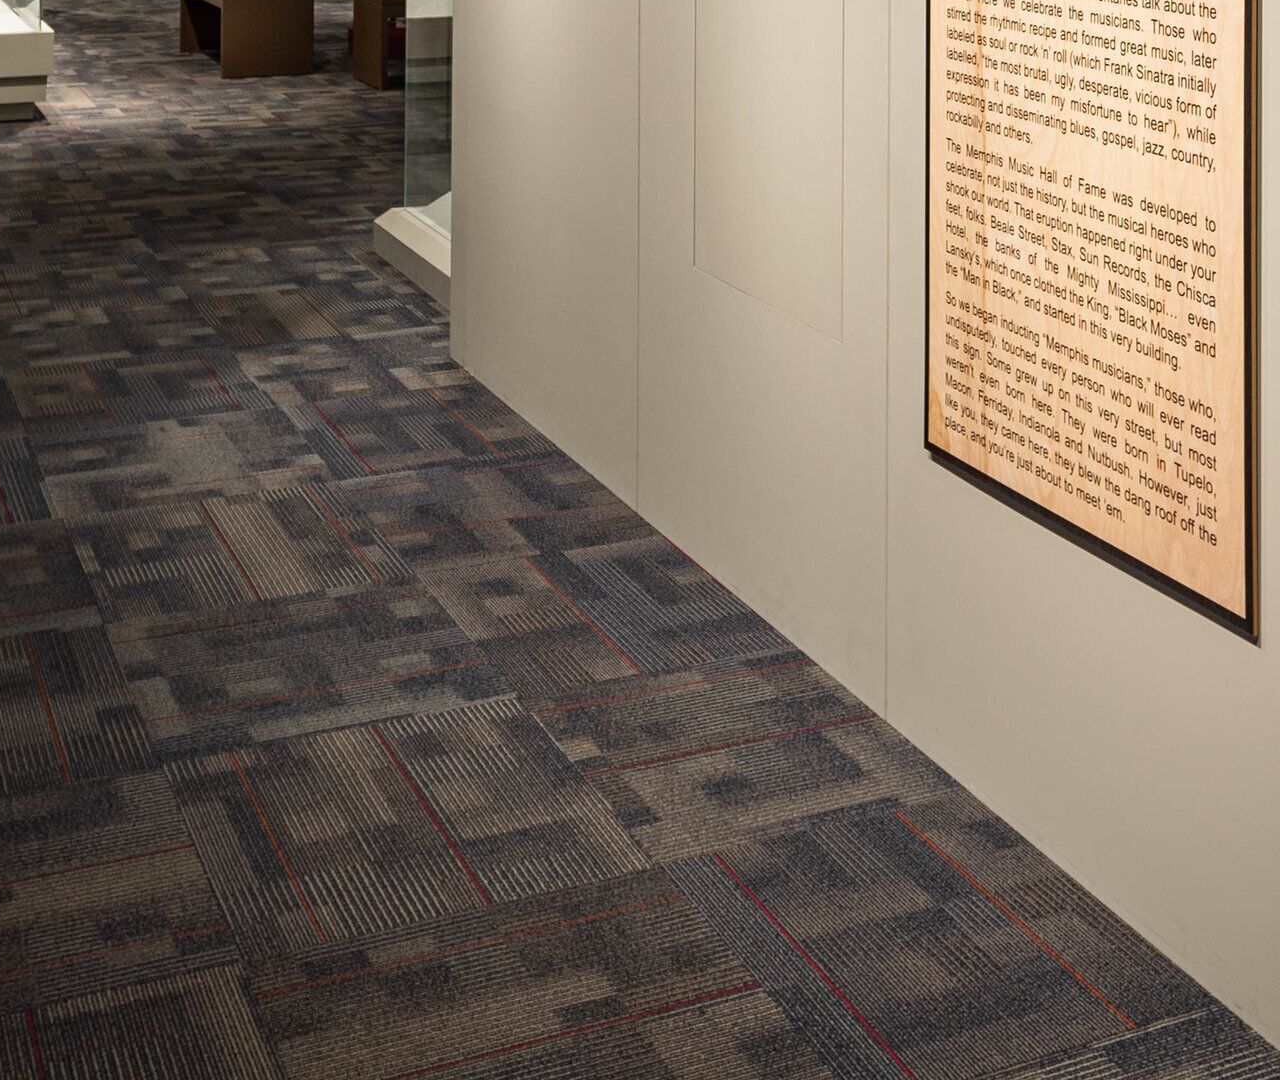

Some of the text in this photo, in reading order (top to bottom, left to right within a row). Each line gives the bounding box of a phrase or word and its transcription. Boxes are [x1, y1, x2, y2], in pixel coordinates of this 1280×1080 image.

[946, 5, 1217, 70] stirred the rhythmic recipe and formed great music, later
[1068, 4, 1083, 21] the
[1090, 11, 1143, 31] musicians.
[1150, 17, 1184, 39] Those
[1192, 26, 1216, 44] who
[1198, 1, 1216, 19] the
[946, 109, 1032, 144] rockabilly and others.
[945, 136, 1216, 233] The Memphis Music Hall of Fame was developed to
[946, 179, 969, 198] shook
[971, 189, 984, 204] our
[1014, 200, 1033, 221] That
[1036, 211, 1073, 234] eruption
[1076, 221, 1125, 252] happened
[1129, 240, 1152, 262] right
[1155, 251, 1187, 274] under
[1190, 263, 1216, 284] your
[990, 214, 1014, 236] Beale
[1018, 223, 1047, 250] Street,
[1051, 235, 1074, 260] Stax,
[1079, 245, 1098, 266] Sun
[1103, 253, 1149, 287] Records,
[1154, 272, 1171, 293] the
[1176, 279, 1215, 309] Chisca
[945, 331, 959, 350] this
[986, 350, 1011, 375] Some
[1015, 366, 1037, 387] grew
[1042, 379, 1053, 398] up
[1058, 386, 1070, 403] on
[1075, 392, 1092, 413] this
[1097, 404, 1119, 430] very
[1125, 417, 1157, 446] street,
[1164, 432, 1182, 456] but
[1188, 447, 1216, 472] most
